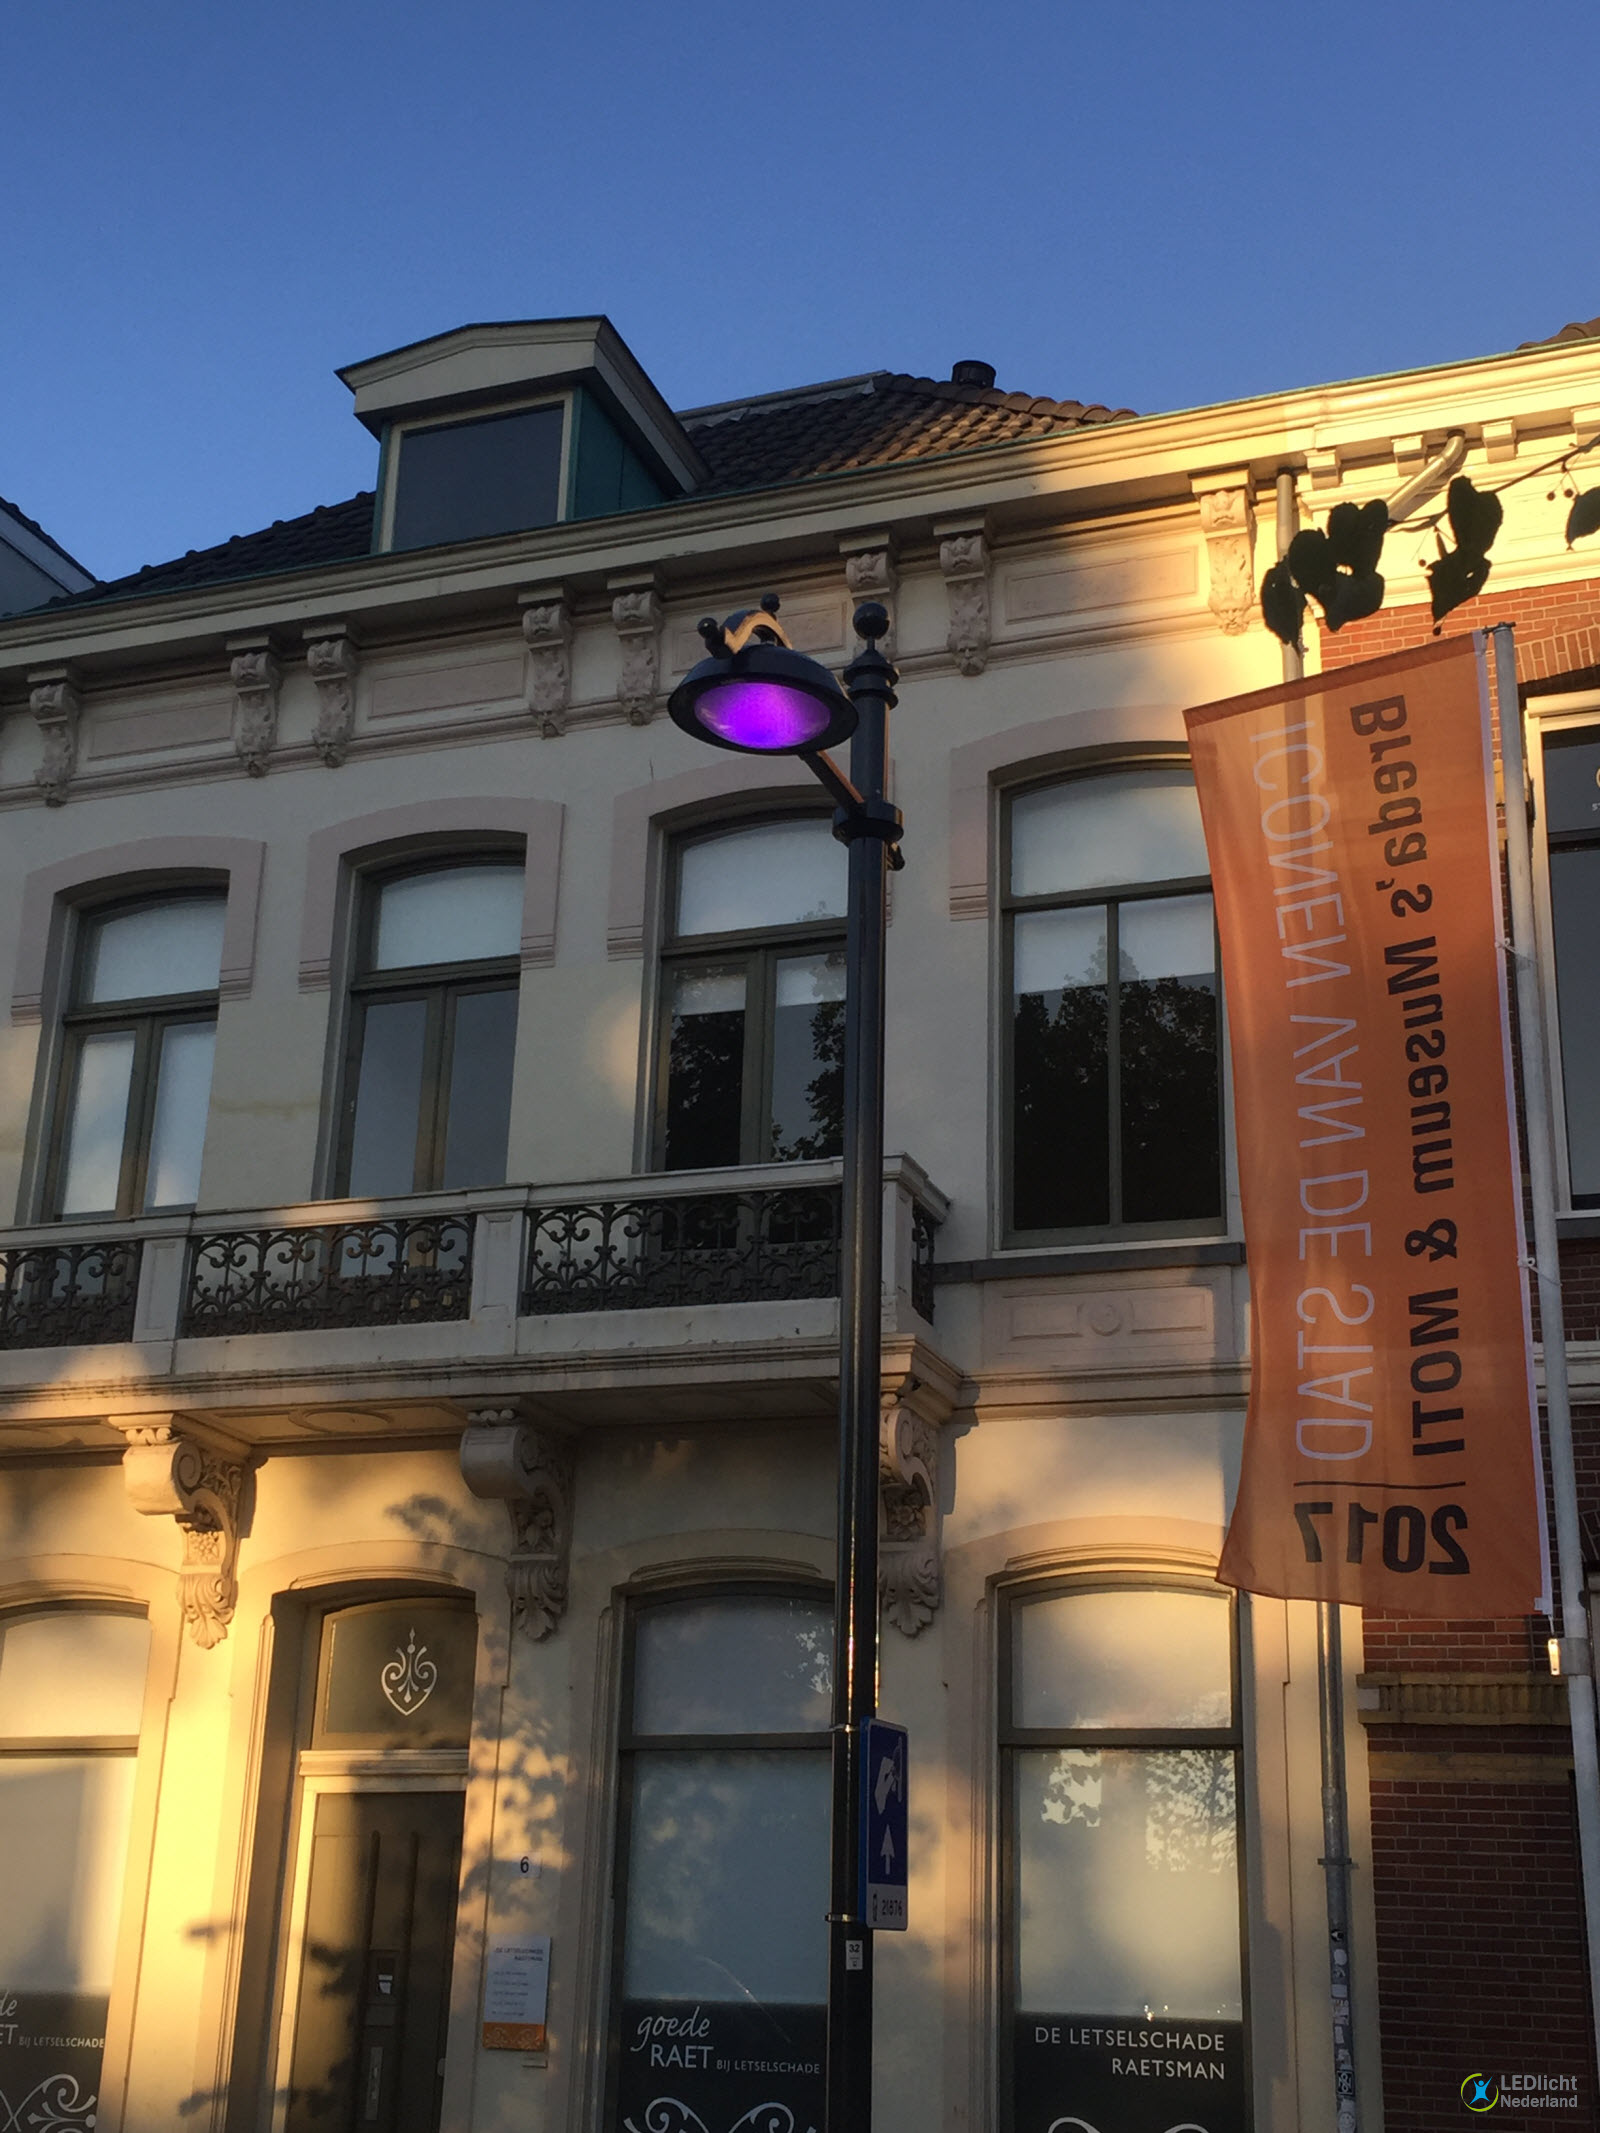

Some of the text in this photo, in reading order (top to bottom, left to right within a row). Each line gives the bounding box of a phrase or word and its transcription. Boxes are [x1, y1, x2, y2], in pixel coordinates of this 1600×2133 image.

[520, 1856, 530, 1873] 6
[848, 1944, 860, 1953] 32
[630, 2006, 710, 2052] goede
[1035, 2027, 1225, 2052] DE LETSELSCHADE
[33, 2037, 104, 2048] LETSELSCHADE
[650, 2044, 820, 2074] RAET BIJ LETSELSCHADE
[1112, 2058, 1225, 2080] RAETSMAN
